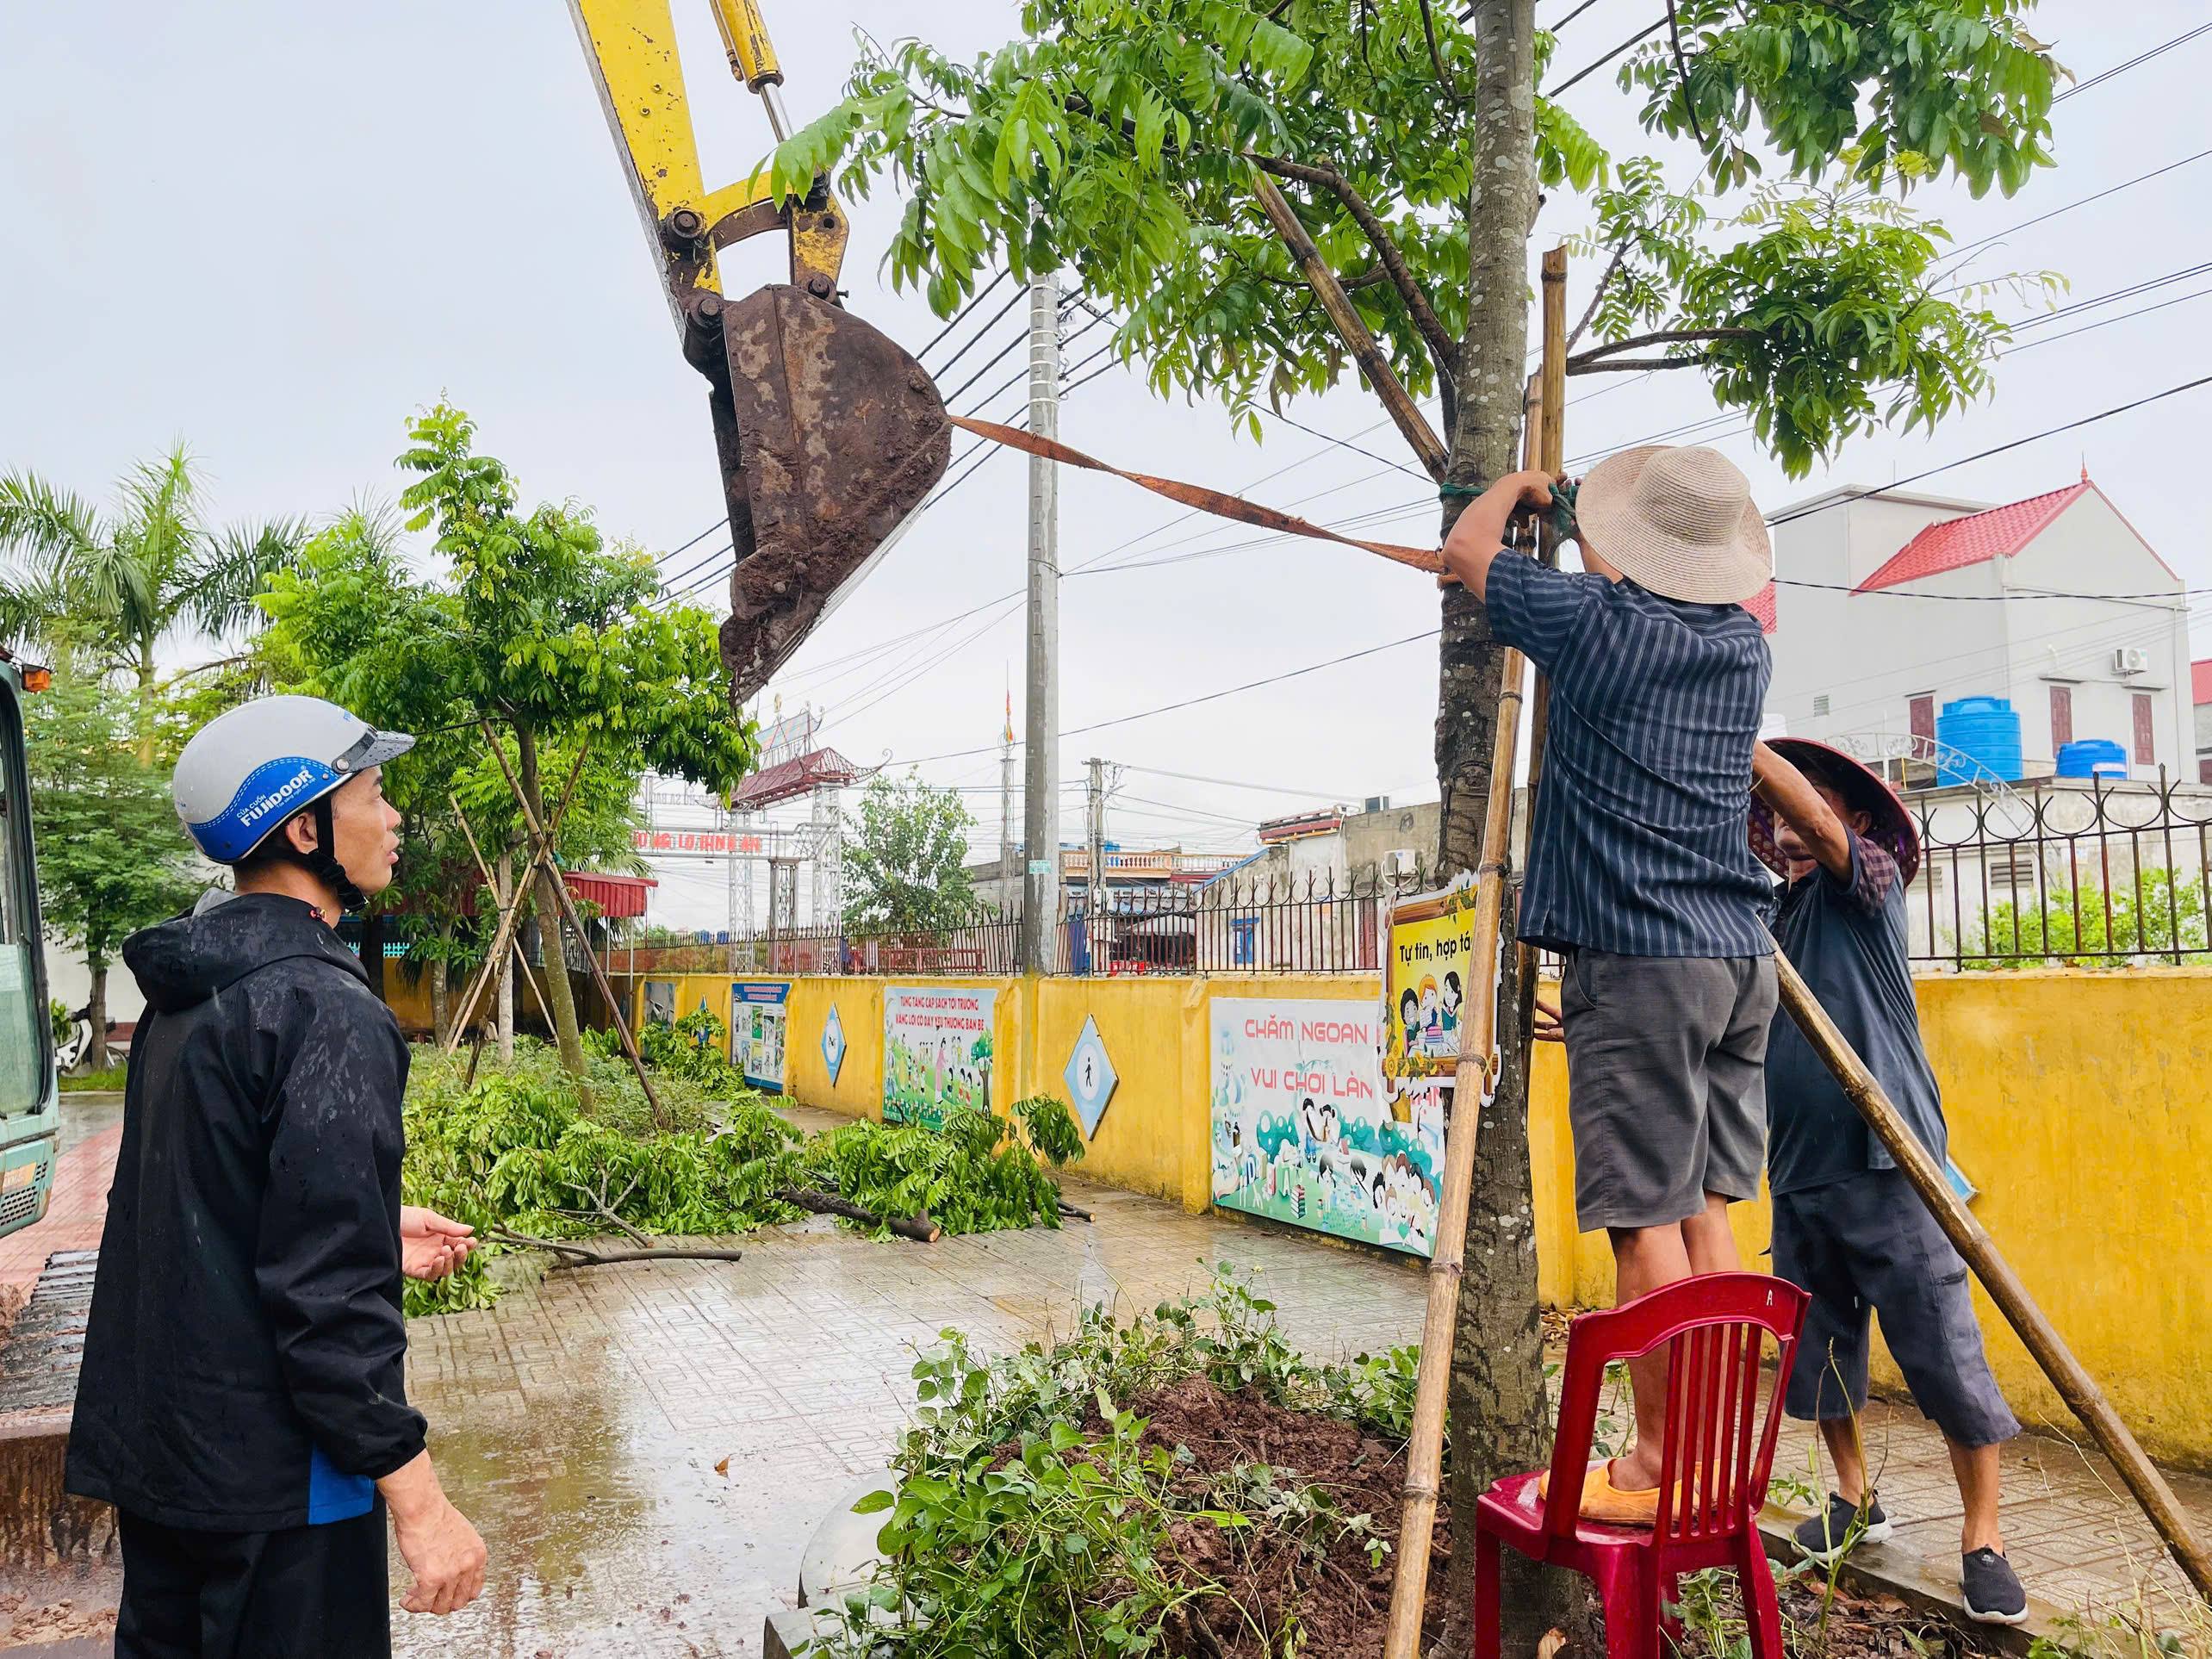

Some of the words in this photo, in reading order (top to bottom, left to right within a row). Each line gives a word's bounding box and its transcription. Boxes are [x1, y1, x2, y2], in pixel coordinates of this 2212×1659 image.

[1415, 942, 1432, 961] tin,
[1436, 938, 1457, 960] hợp
[1460, 930, 1473, 952] tá
[1246, 1014, 1294, 1041] CHĂM
[1302, 1021, 1368, 1044] NGOAN
[1250, 1067, 1277, 1089] VUI
